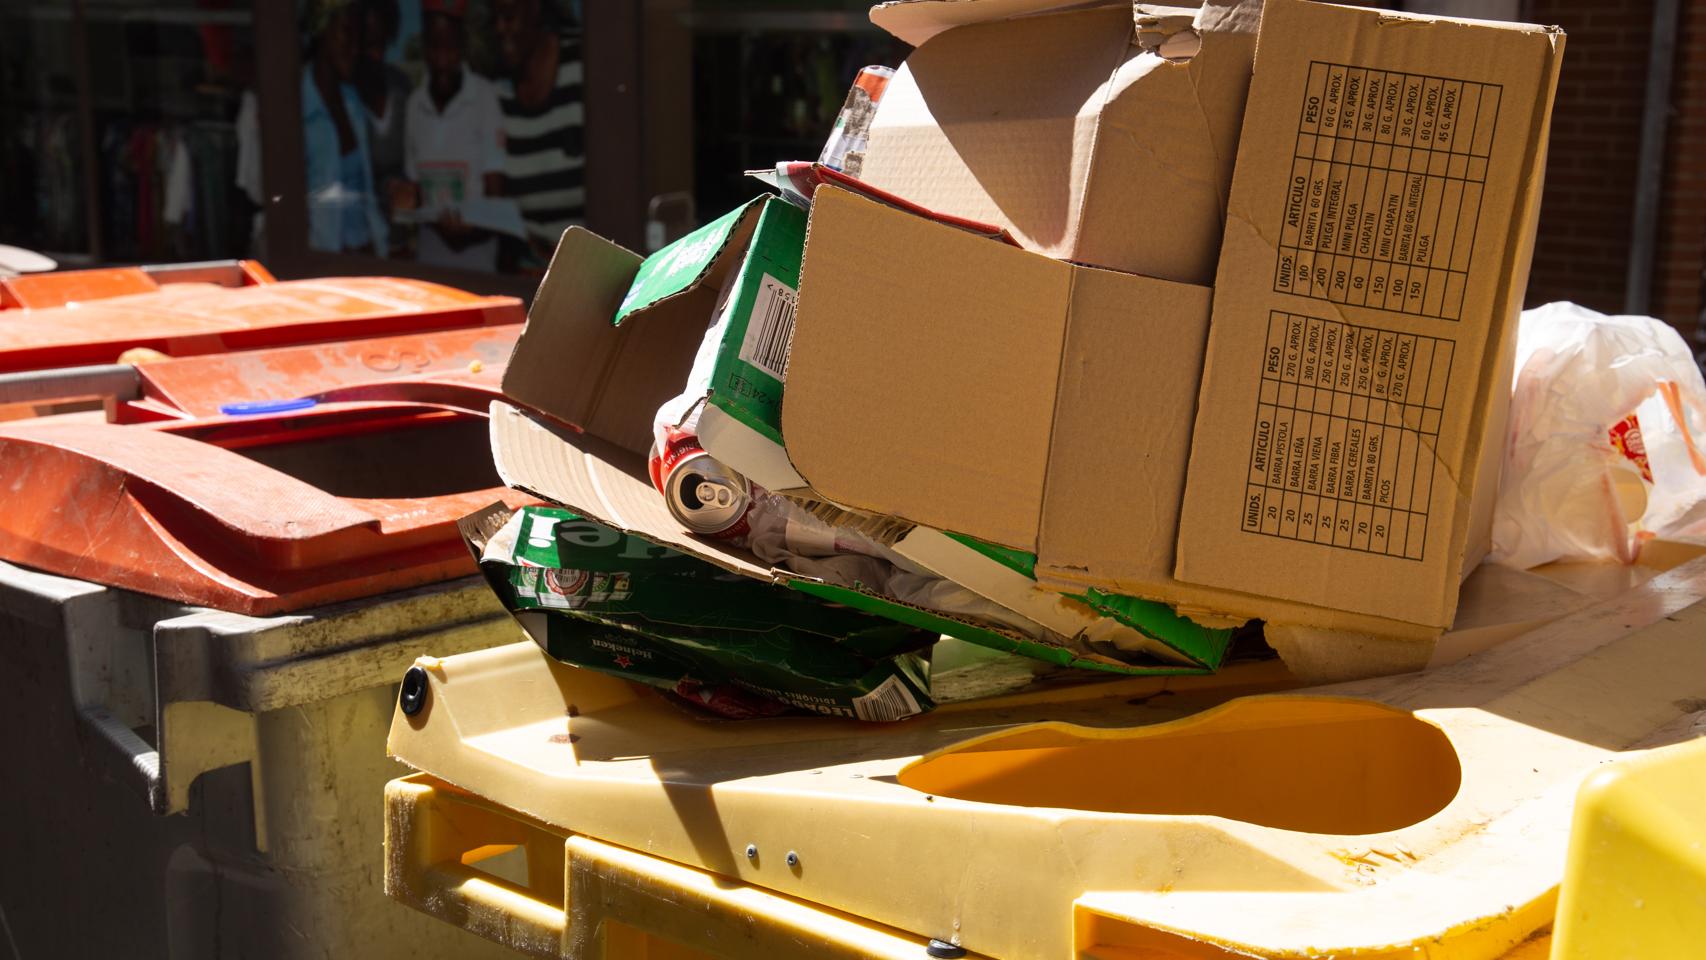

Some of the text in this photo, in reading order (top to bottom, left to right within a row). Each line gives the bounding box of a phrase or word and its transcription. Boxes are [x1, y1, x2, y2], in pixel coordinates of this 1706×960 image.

[1304, 95, 1320, 124] PESO
[1323, 73, 1342, 128] 60 G. APROX.
[1341, 75, 1361, 129] 35 G. APROX.
[1360, 77, 1381, 132] 30 G. APROX.
[1379, 79, 1400, 135] 80 G. APROX.
[1399, 82, 1420, 137] 30 G. APROX.
[1419, 85, 1439, 141] 60 G. APROX.
[1437, 87, 1457, 143] 45 G. APROX.
[1286, 175, 1306, 228] ARTICULO
[1302, 177, 1324, 247] BARRITA 60 GRS.
[1320, 179, 1343, 249] PULGA INTEGRAL
[1340, 202, 1359, 252] MINI PULGA
[1378, 193, 1400, 258] MINI CHAPATIN
[1397, 175, 1423, 262] BARRITA 60 GRS. INTEGRAL
[1358, 211, 1376, 254] CHAPATIN
[1415, 234, 1431, 263] PULGA
[1277, 254, 1293, 288] UNIDS.
[1315, 266, 1327, 288] 200
[1333, 269, 1346, 290] 200
[1352, 275, 1365, 290] 60
[1371, 275, 1385, 294] 150
[1391, 278, 1404, 297] 100
[1408, 280, 1422, 300] 150
[1266, 345, 1281, 374] PESO
[1284, 320, 1302, 377] 270 G. APROX.
[1303, 323, 1320, 381] 300 G. APROX.
[1320, 326, 1338, 384] 250 G. APROX.
[1338, 328, 1355, 387] 250 G. APROX.
[1356, 333, 1374, 391] 250 G. APROX.
[1374, 336, 1393, 394] 80 G. APROX.
[1391, 338, 1412, 397] 270 G. APROX.
[1253, 419, 1271, 472] ARTICULO
[1270, 421, 1289, 485] BARRA PISTOLA
[1288, 436, 1305, 488] BARRA LEÑA
[1306, 435, 1323, 491] BARRA VIENA
[1324, 440, 1341, 494] BARRA FIBRA
[1342, 427, 1361, 497] BARRA CEREALES
[1360, 433, 1379, 501] BARRITA 80 GRS.
[1246, 492, 1261, 527] UNIDS.
[1266, 505, 1278, 520] 20
[1284, 508, 1296, 523] 20
[1378, 478, 1391, 504] PICOS
[1301, 511, 1313, 526] 25
[1320, 514, 1332, 529] 25
[1338, 517, 1350, 532] 25
[1356, 520, 1368, 535] 70
[1373, 523, 1385, 538] 20
[591, 639, 653, 659] Heineken
